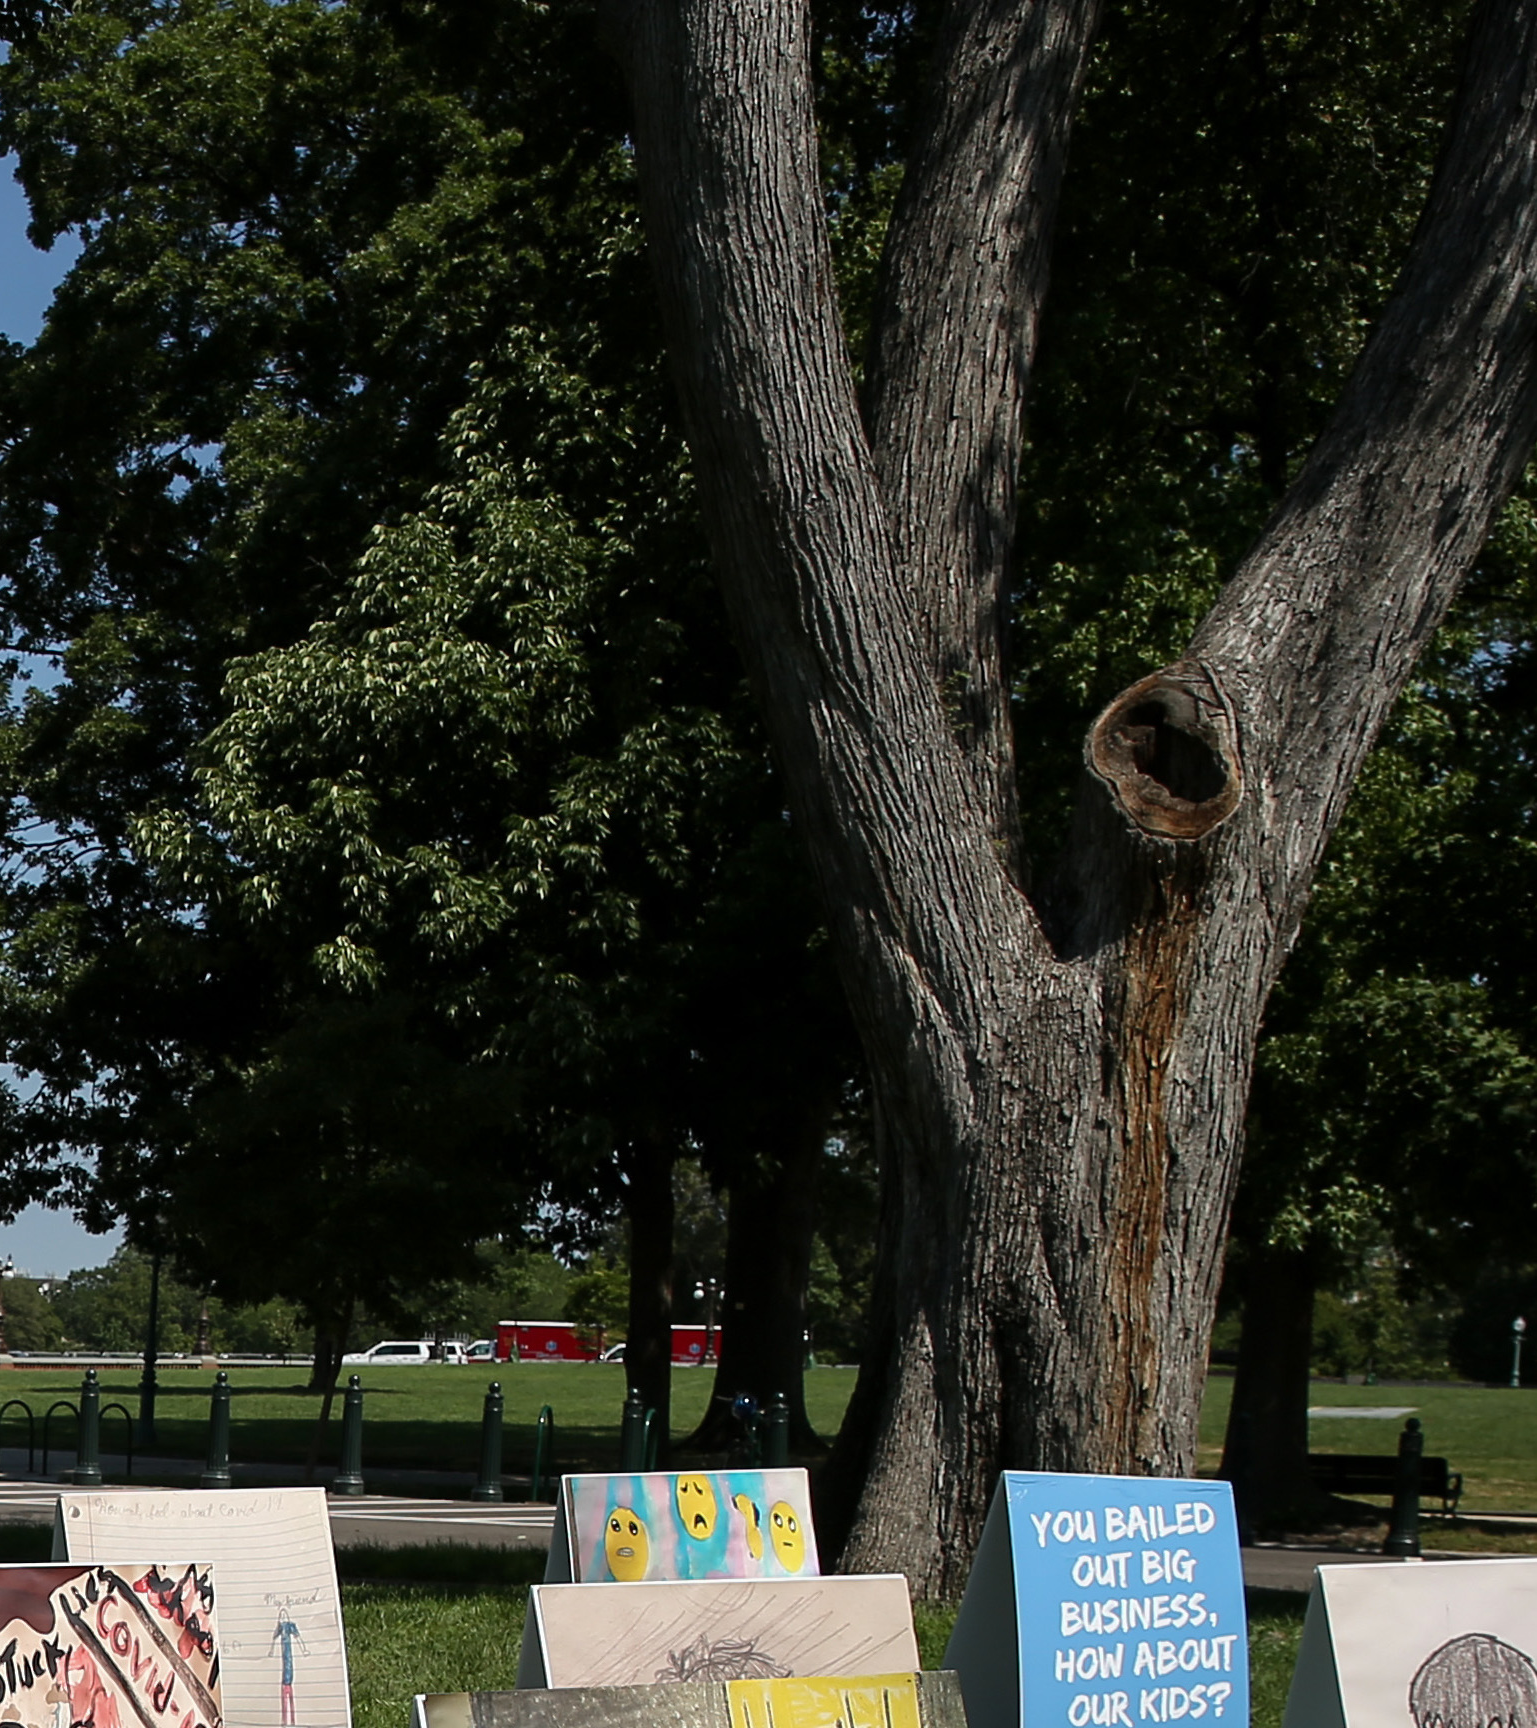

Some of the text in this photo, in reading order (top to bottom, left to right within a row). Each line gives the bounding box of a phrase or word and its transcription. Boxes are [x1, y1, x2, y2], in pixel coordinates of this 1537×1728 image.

[1030, 1502, 1217, 1548] YOU BAILED
[1072, 1549, 1197, 1588] OUT BIG
[1060, 1592, 1219, 1637] BUSINESS,
[1055, 1634, 1239, 1684] HOW ABOUT
[1067, 1682, 1233, 1728] OUR KIDS?
